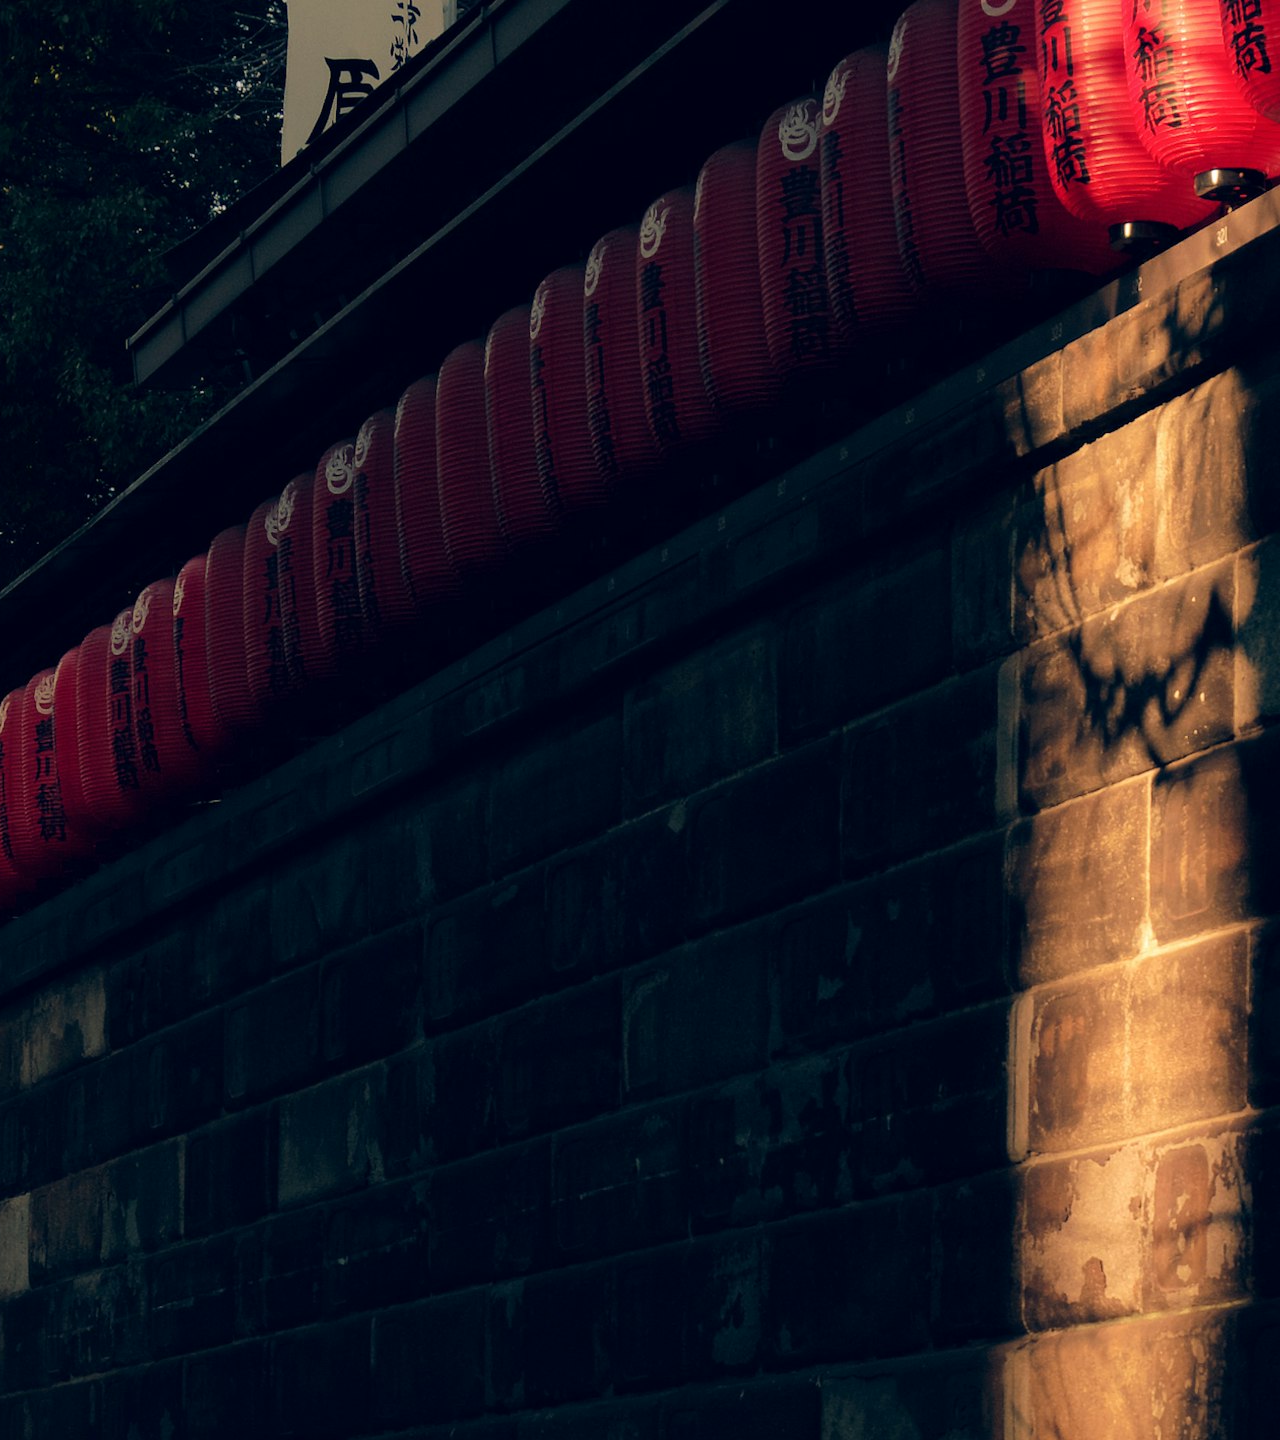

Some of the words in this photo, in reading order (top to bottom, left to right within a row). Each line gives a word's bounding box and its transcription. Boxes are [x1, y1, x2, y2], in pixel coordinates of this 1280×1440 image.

[980, 21, 1040, 236] 豊川稲荷
[1215, 226, 1229, 247] 321
